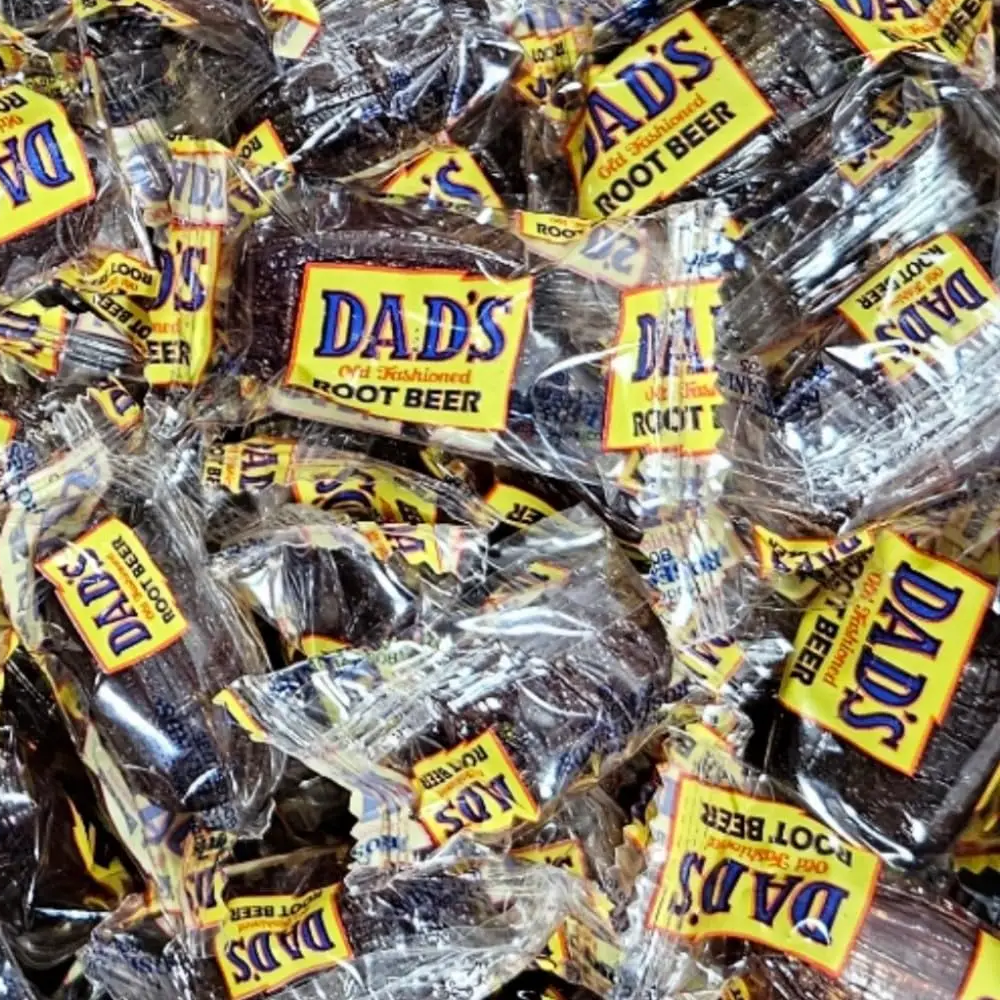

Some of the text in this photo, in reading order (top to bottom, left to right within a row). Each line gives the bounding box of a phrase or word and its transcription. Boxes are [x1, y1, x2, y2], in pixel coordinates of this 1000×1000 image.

[594, 99, 738, 219] ROOT BEER
[314, 289, 513, 363] DAD'S
[312, 379, 482, 414] ROOT BEER
[377, 364, 472, 386] Fashioned
[110, 534, 176, 625] ROOT BEER
[789, 613, 840, 687] BEER
[838, 560, 964, 753] DAD'S
[699, 802, 765, 843] BEER
[230, 904, 276, 921] BEER
[668, 851, 850, 947] DAD'S
[224, 907, 336, 984] DAD'S
